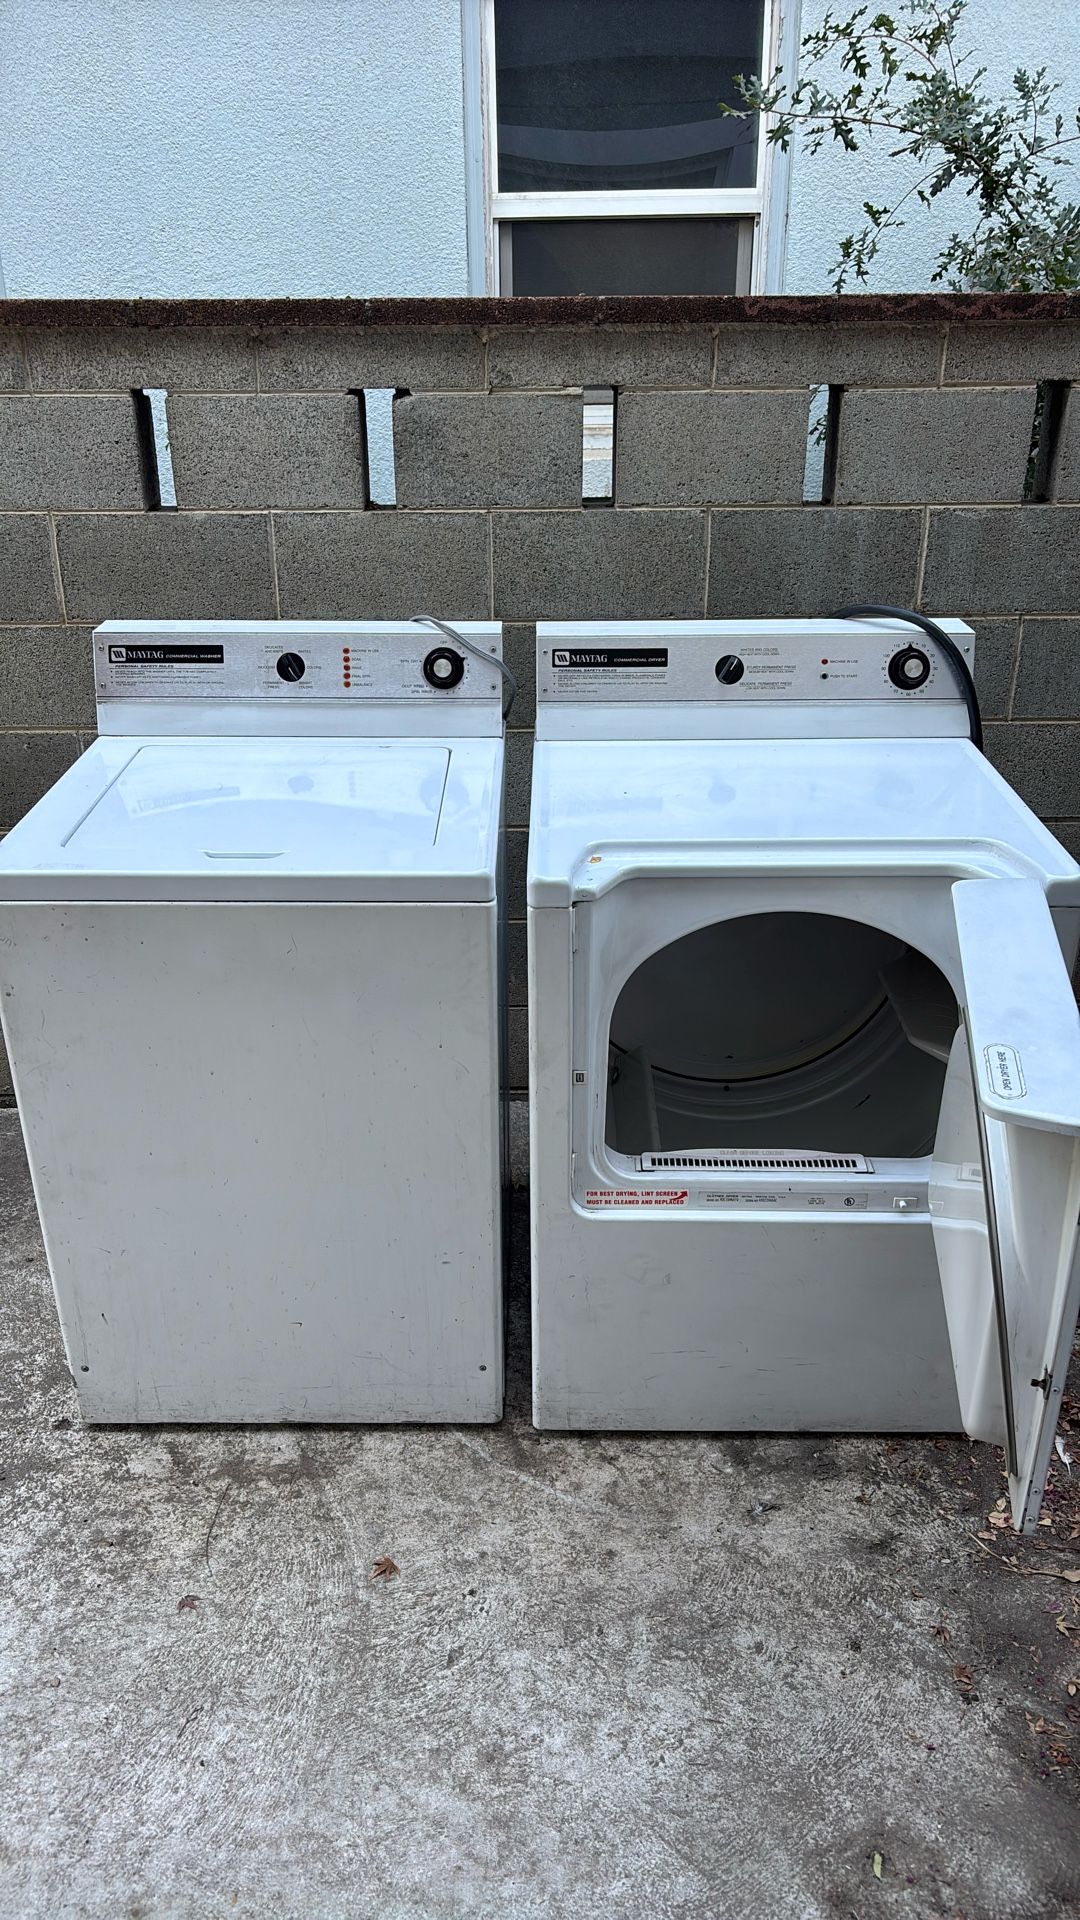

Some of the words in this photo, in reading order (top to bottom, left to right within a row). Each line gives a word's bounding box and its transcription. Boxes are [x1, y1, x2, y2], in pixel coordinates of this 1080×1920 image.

[127, 651, 164, 659] MAYTAG
[571, 654, 608, 663] MAYTAG
[997, 1051, 1007, 1063] HERE
[999, 1063, 1010, 1078] DRYER
[1003, 1078, 1012, 1090] OPEN
